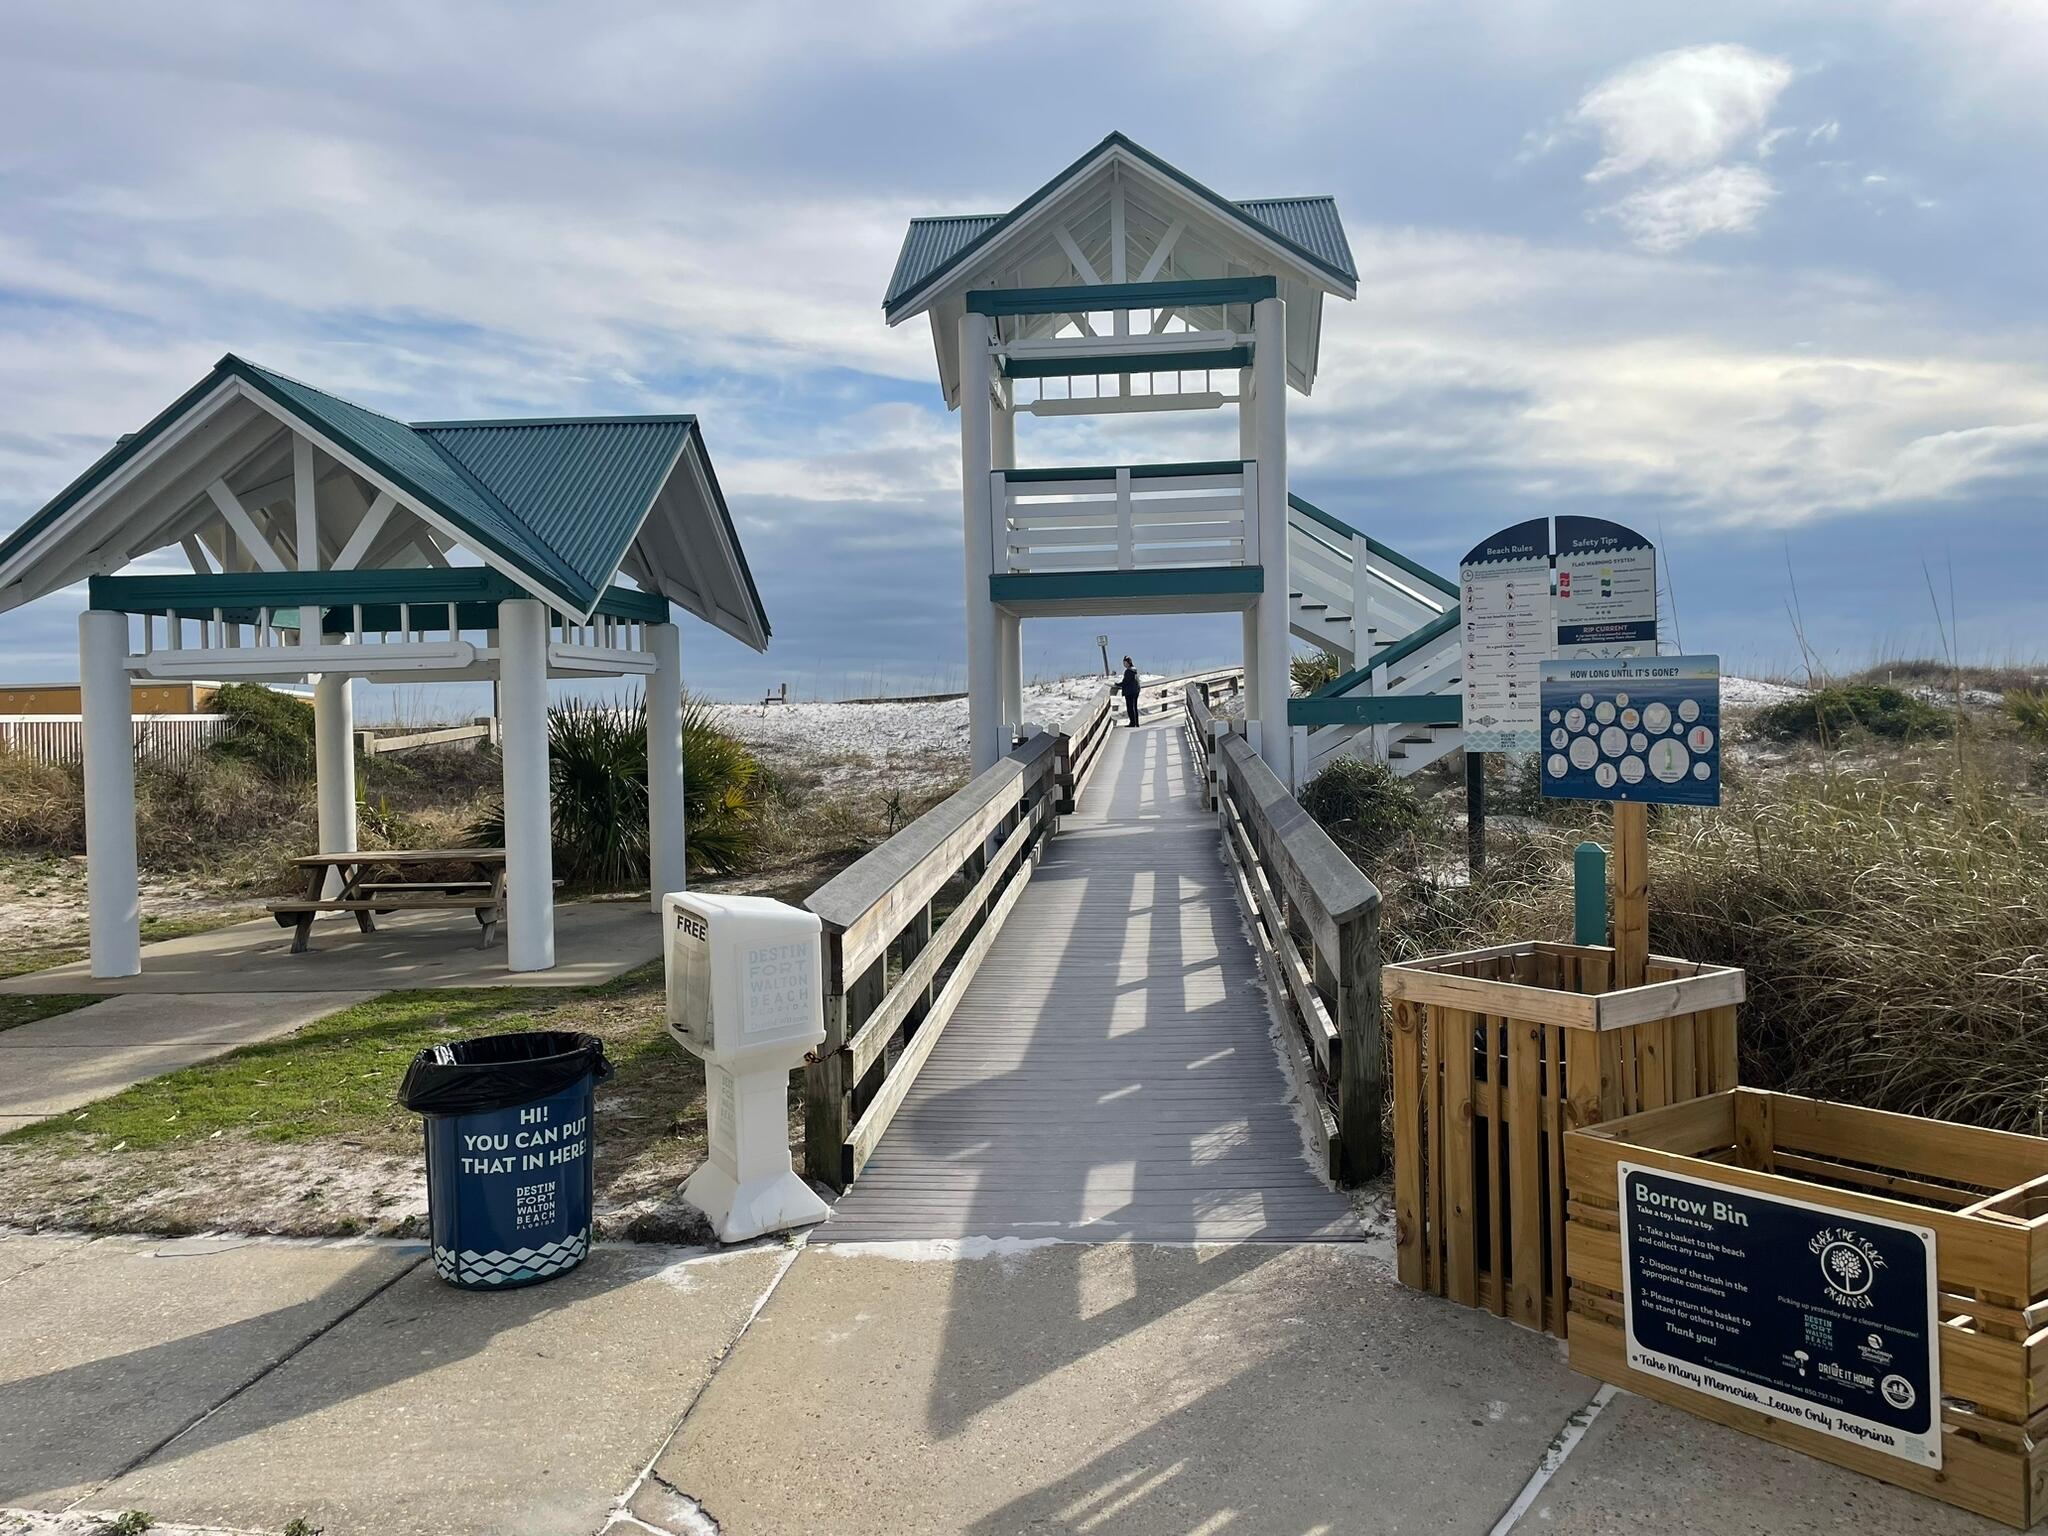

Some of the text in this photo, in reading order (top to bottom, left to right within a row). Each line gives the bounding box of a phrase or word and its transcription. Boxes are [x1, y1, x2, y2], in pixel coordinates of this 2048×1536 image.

[1487, 545, 1533, 555] Beach Rules
[1572, 537, 1618, 547] Safety Tips
[1570, 668, 1679, 678] HOW LONG UNTIL IT'S GONE?
[677, 915, 706, 942] FREE
[749, 943, 807, 964] DESTIN
[750, 960, 807, 978] FORT
[750, 974, 808, 993] WALTON
[751, 989, 808, 1008] BEACH
[520, 1105, 548, 1125] HI!
[464, 1116, 587, 1151] YOU CAN PUT
[461, 1138, 587, 1174] THAT IN HERE!
[516, 1181, 556, 1197] DESTIN
[517, 1192, 555, 1206] FORT
[517, 1201, 555, 1215] WALTON
[1635, 1183, 1749, 1227] Borrow Bin
[516, 1210, 555, 1225] BEACH
[516, 1219, 555, 1230] FLORIDA
[1636, 1204, 1653, 1216] Take
[1660, 1212, 1673, 1221] toy,
[1674, 1214, 1693, 1225] leave
[1699, 1221, 1714, 1231] toy.
[1638, 1236, 1714, 1261] and collect any trash
[1646, 1225, 1663, 1237] Take
[1671, 1232, 1695, 1246] basket
[1696, 1239, 1706, 1248] to
[1707, 1240, 1720, 1252] the
[1721, 1244, 1745, 1258] beach
[1808, 1227, 1889, 1269] ERASE THE TRACE
[1640, 1256, 1748, 1293] 2- Dispose of the trash in the
[1641, 1268, 1726, 1298] appropriate containers
[1641, 1287, 1752, 1327] 3- Please return the basket to
[1823, 1286, 1874, 1309] OKALOOSA
[1641, 1299, 1740, 1335] the stand for others to use
[1777, 1295, 1801, 1309] Picking
[1810, 1305, 1841, 1319] yesterday
[1842, 1312, 1852, 1321] for
[1858, 1318, 1883, 1329] cleaner
[1803, 1314, 1833, 1328] DESTIN
[1665, 1321, 1717, 1346] Thank you!
[1804, 1322, 1833, 1334] FORT
[1805, 1328, 1833, 1341] WALTON
[1805, 1334, 1833, 1347] BEACH
[1844, 1370, 1852, 1381] IT
[1853, 1372, 1875, 1388] HOME
[1639, 1353, 1666, 1371] Take
[1667, 1362, 1701, 1387] Many
[1805, 1408, 1832, 1430] Only
[1835, 1418, 1896, 1446] Footprints
